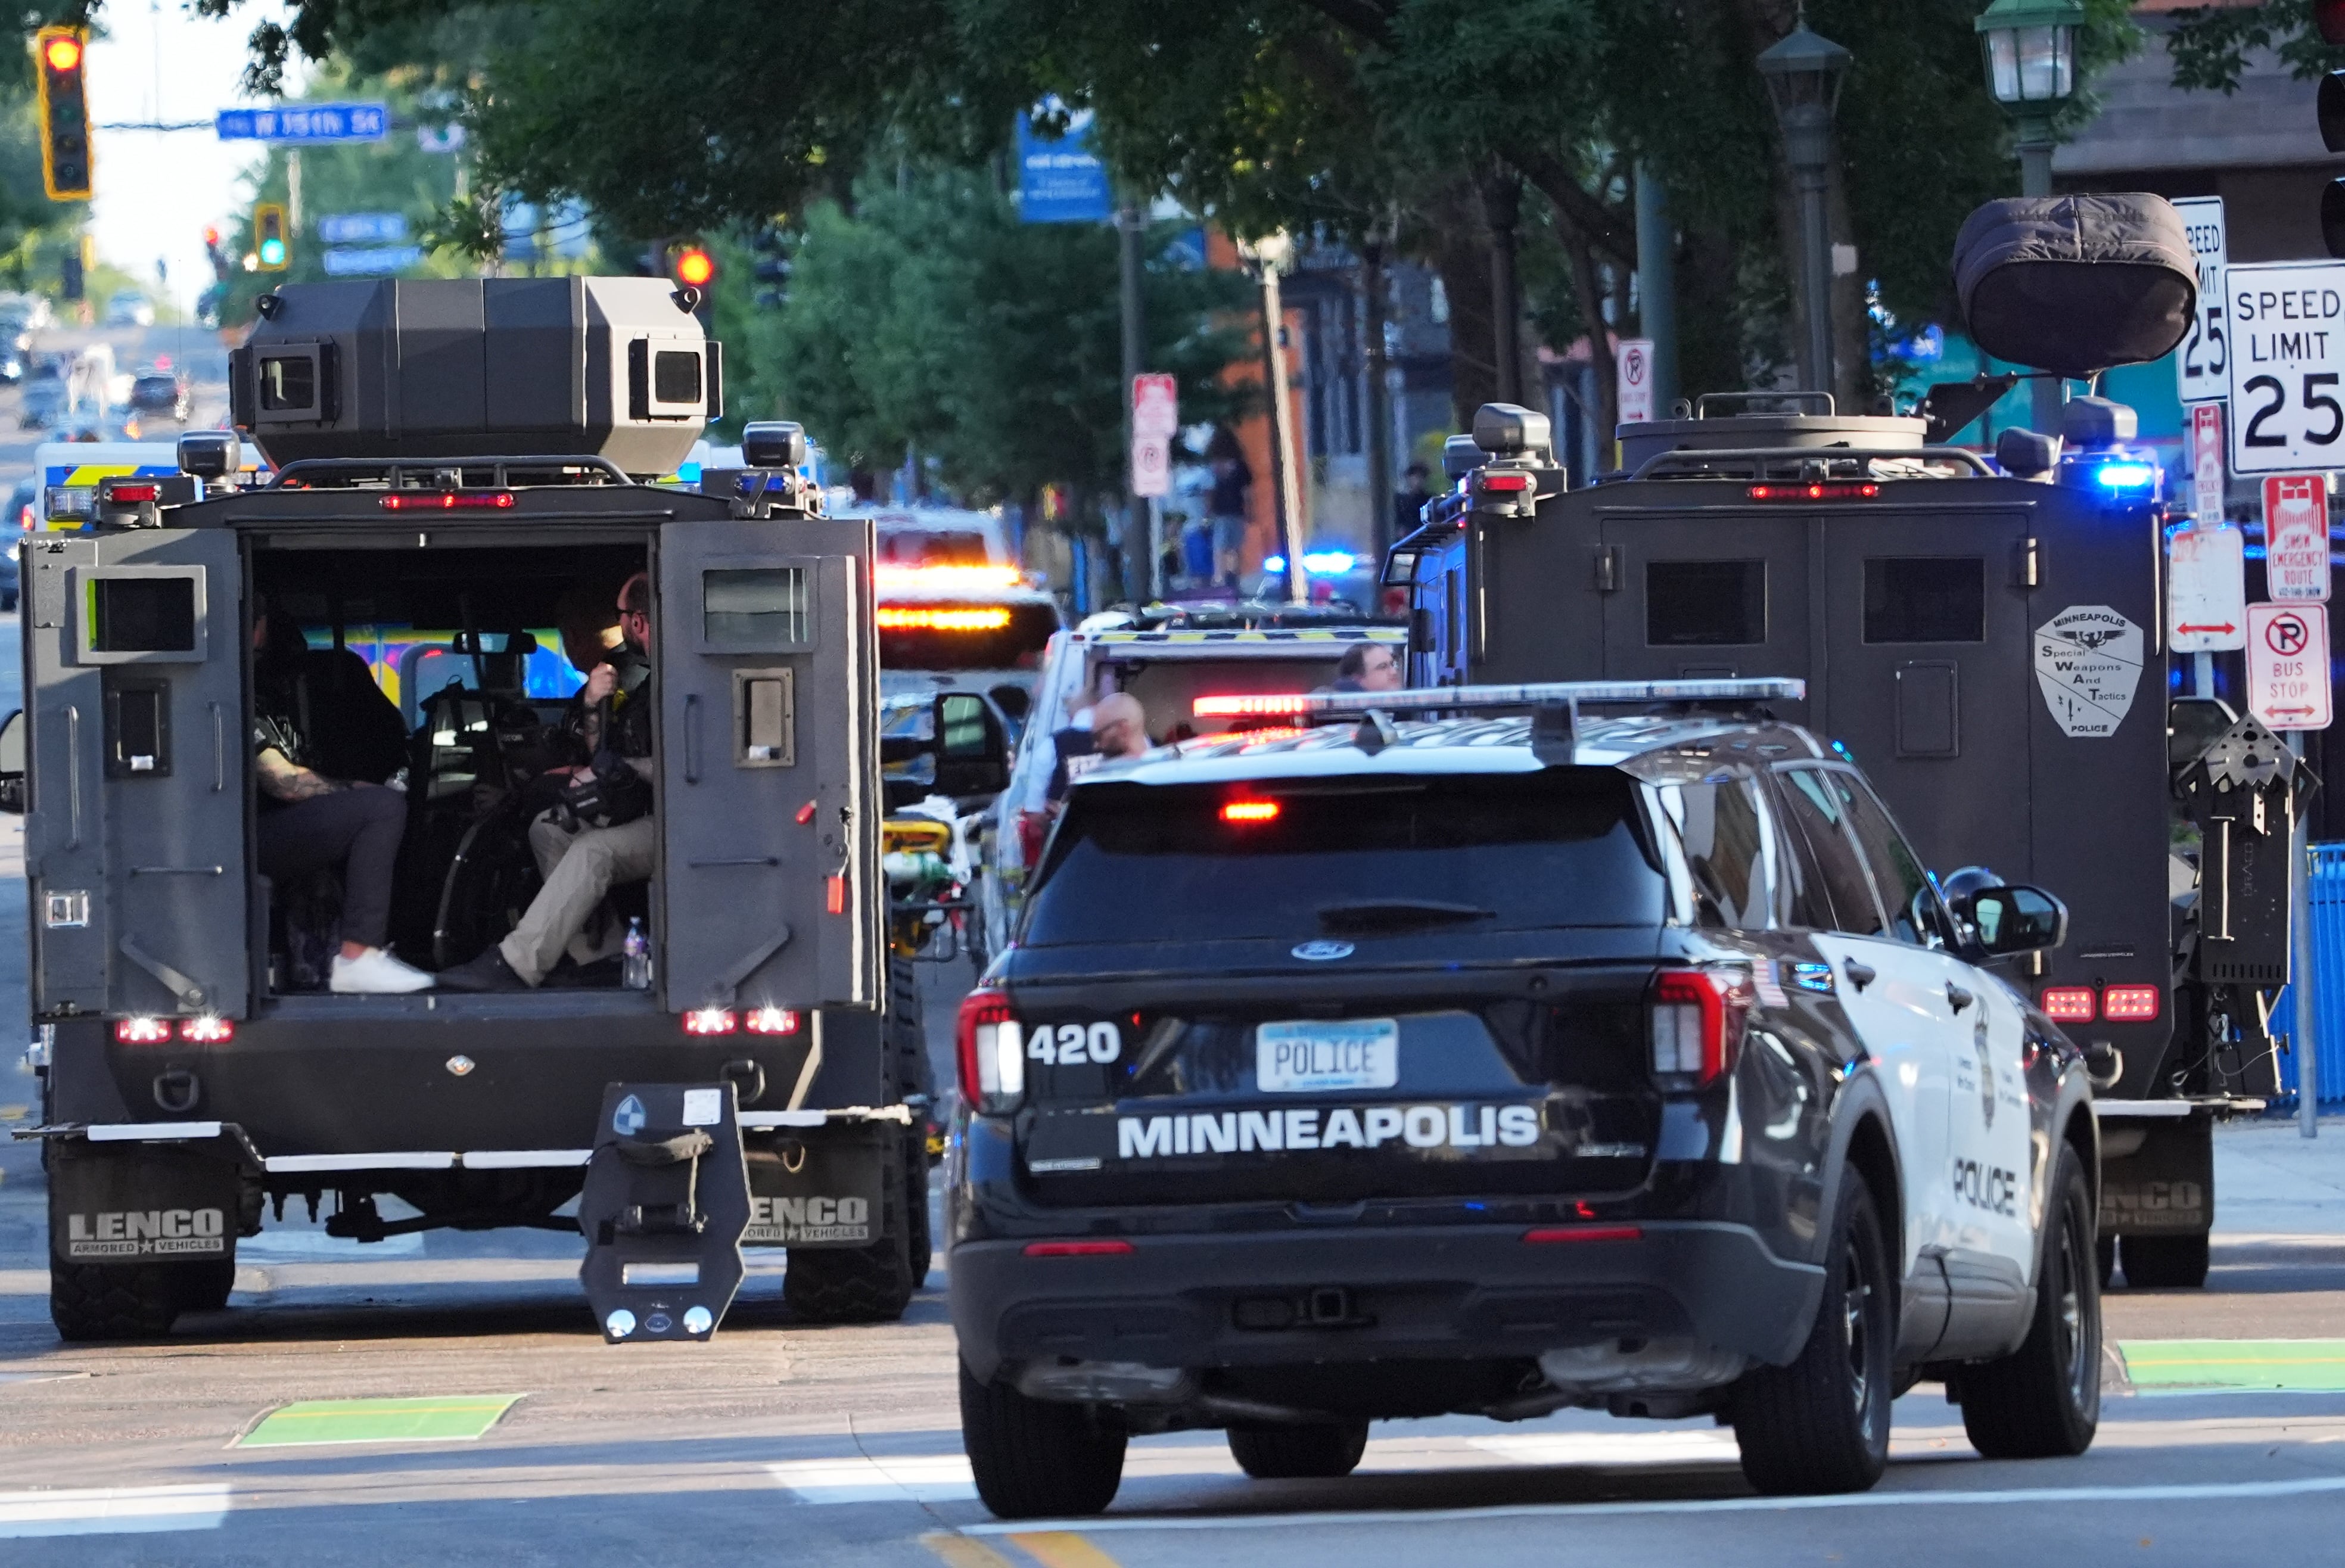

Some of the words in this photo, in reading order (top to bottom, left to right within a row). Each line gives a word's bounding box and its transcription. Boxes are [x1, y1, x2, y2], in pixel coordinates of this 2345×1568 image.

[2185, 224, 2220, 253] PEED
[2198, 266, 2218, 294] MIT
[2237, 290, 2340, 321] SPEED
[2185, 307, 2226, 378] 25
[2251, 331, 2329, 362] LIMIT
[2242, 372, 2344, 450] 25
[2272, 551, 2324, 568] EMERGENCY
[2284, 569, 2313, 586] ROUTE
[2053, 613, 2126, 628] MINNEAPOLIS
[2042, 645, 2085, 659] Special
[2055, 661, 2122, 673] Weapons
[2073, 674, 2101, 685] And
[2273, 662, 2304, 677] BUS
[2088, 688, 2126, 701] Tactics
[2270, 682, 2309, 698] STOP
[1027, 1021, 1121, 1065] 420
[1275, 1040, 1377, 1076] POLICE
[1118, 1105, 1538, 1158] MINNEAPOLIS
[1954, 1158, 2016, 1217] POLICE
[2102, 1181, 2202, 1209] NCO
[69, 1208, 223, 1241] LENCO
[749, 1196, 868, 1226] ENCO
[74, 1243, 135, 1253] ARMORED
[158, 1239, 220, 1251] VEHICLES
[744, 1227, 780, 1239] ORED
[805, 1226, 864, 1239] VEHICLES
